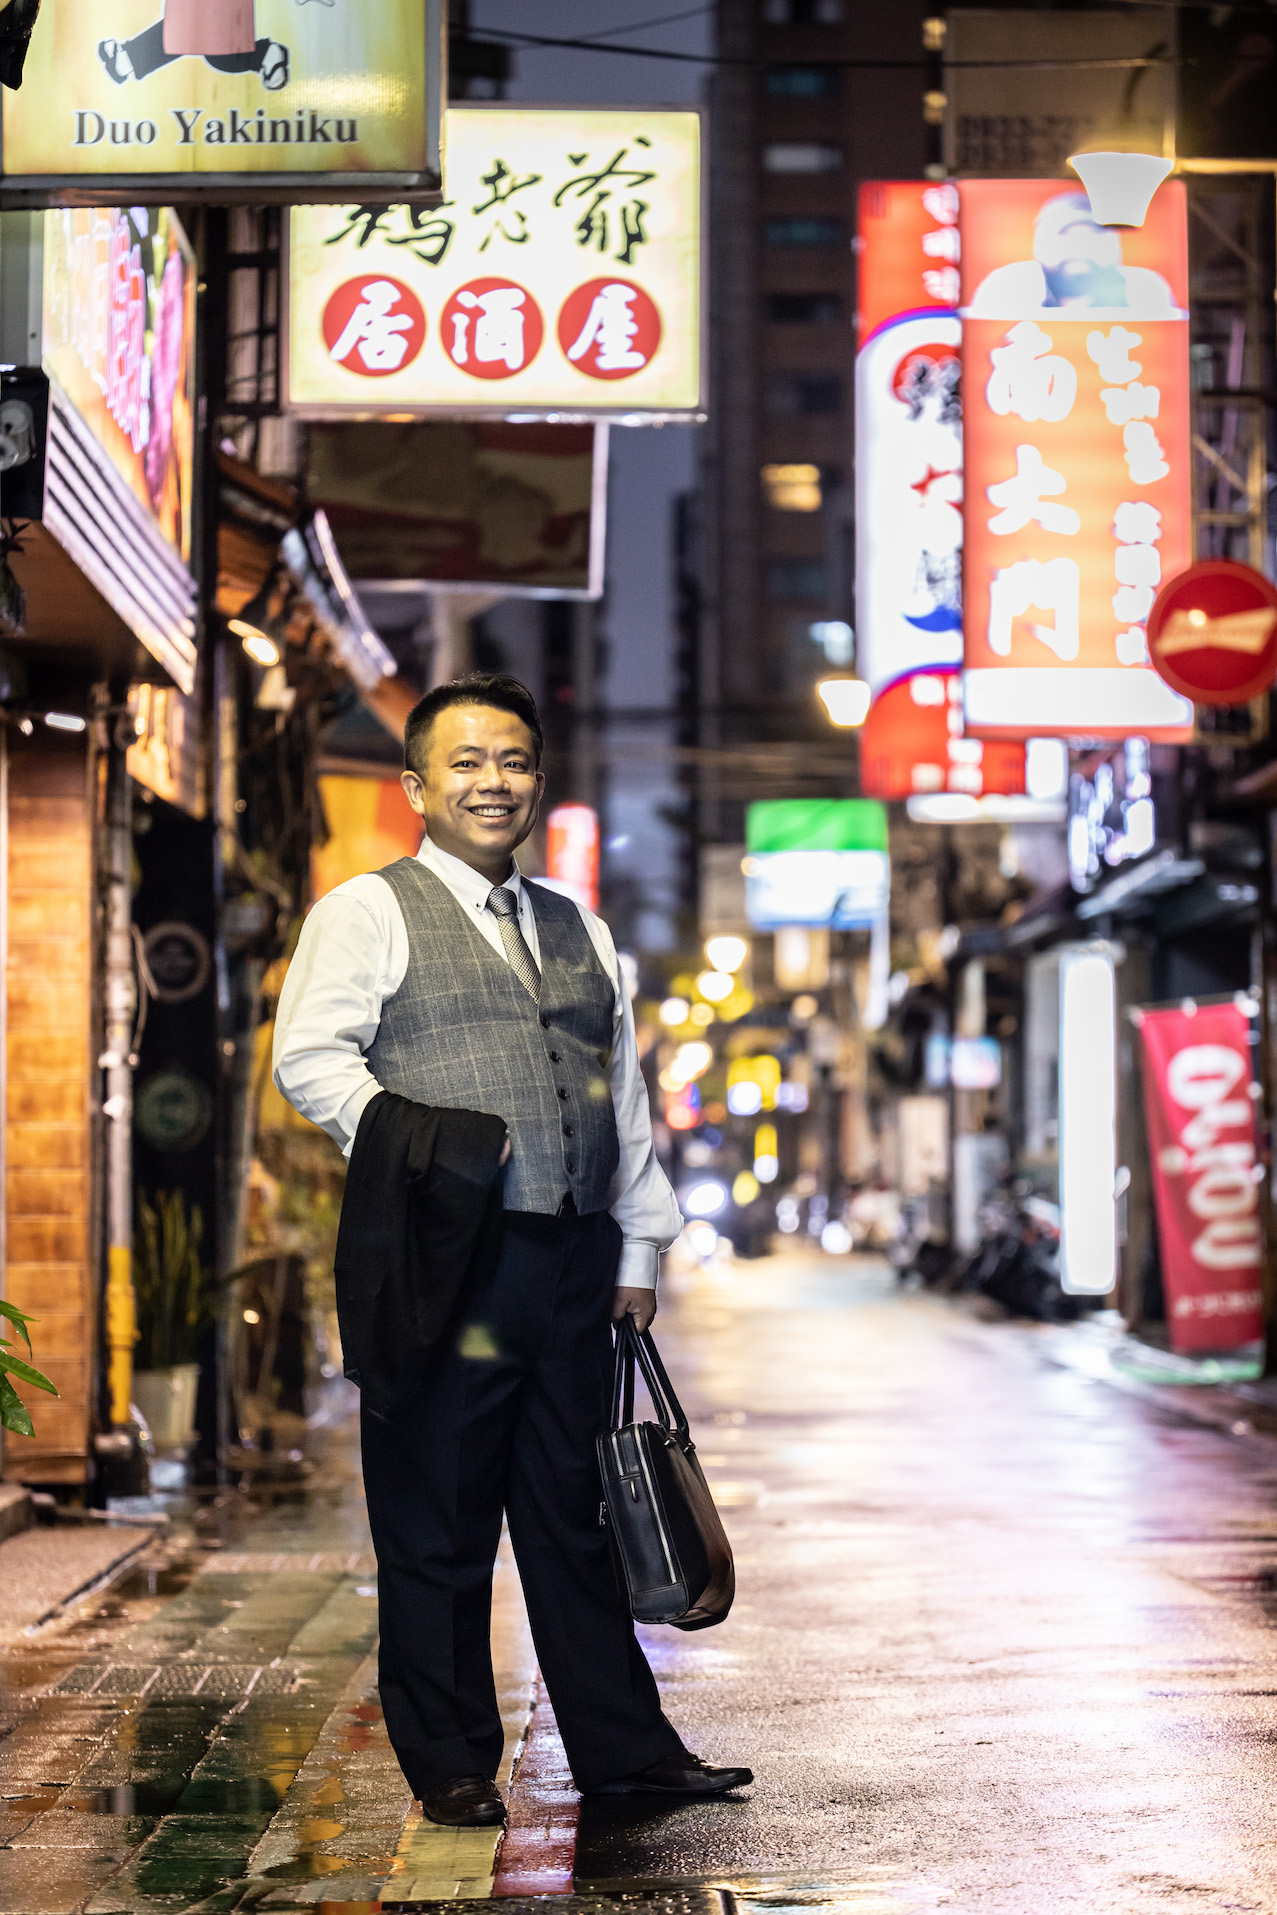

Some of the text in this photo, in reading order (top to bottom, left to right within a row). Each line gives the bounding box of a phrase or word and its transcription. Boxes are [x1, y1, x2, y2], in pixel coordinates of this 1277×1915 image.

[75, 109, 359, 146] Duo Yakiniku
[330, 280, 646, 370] 居酒屋
